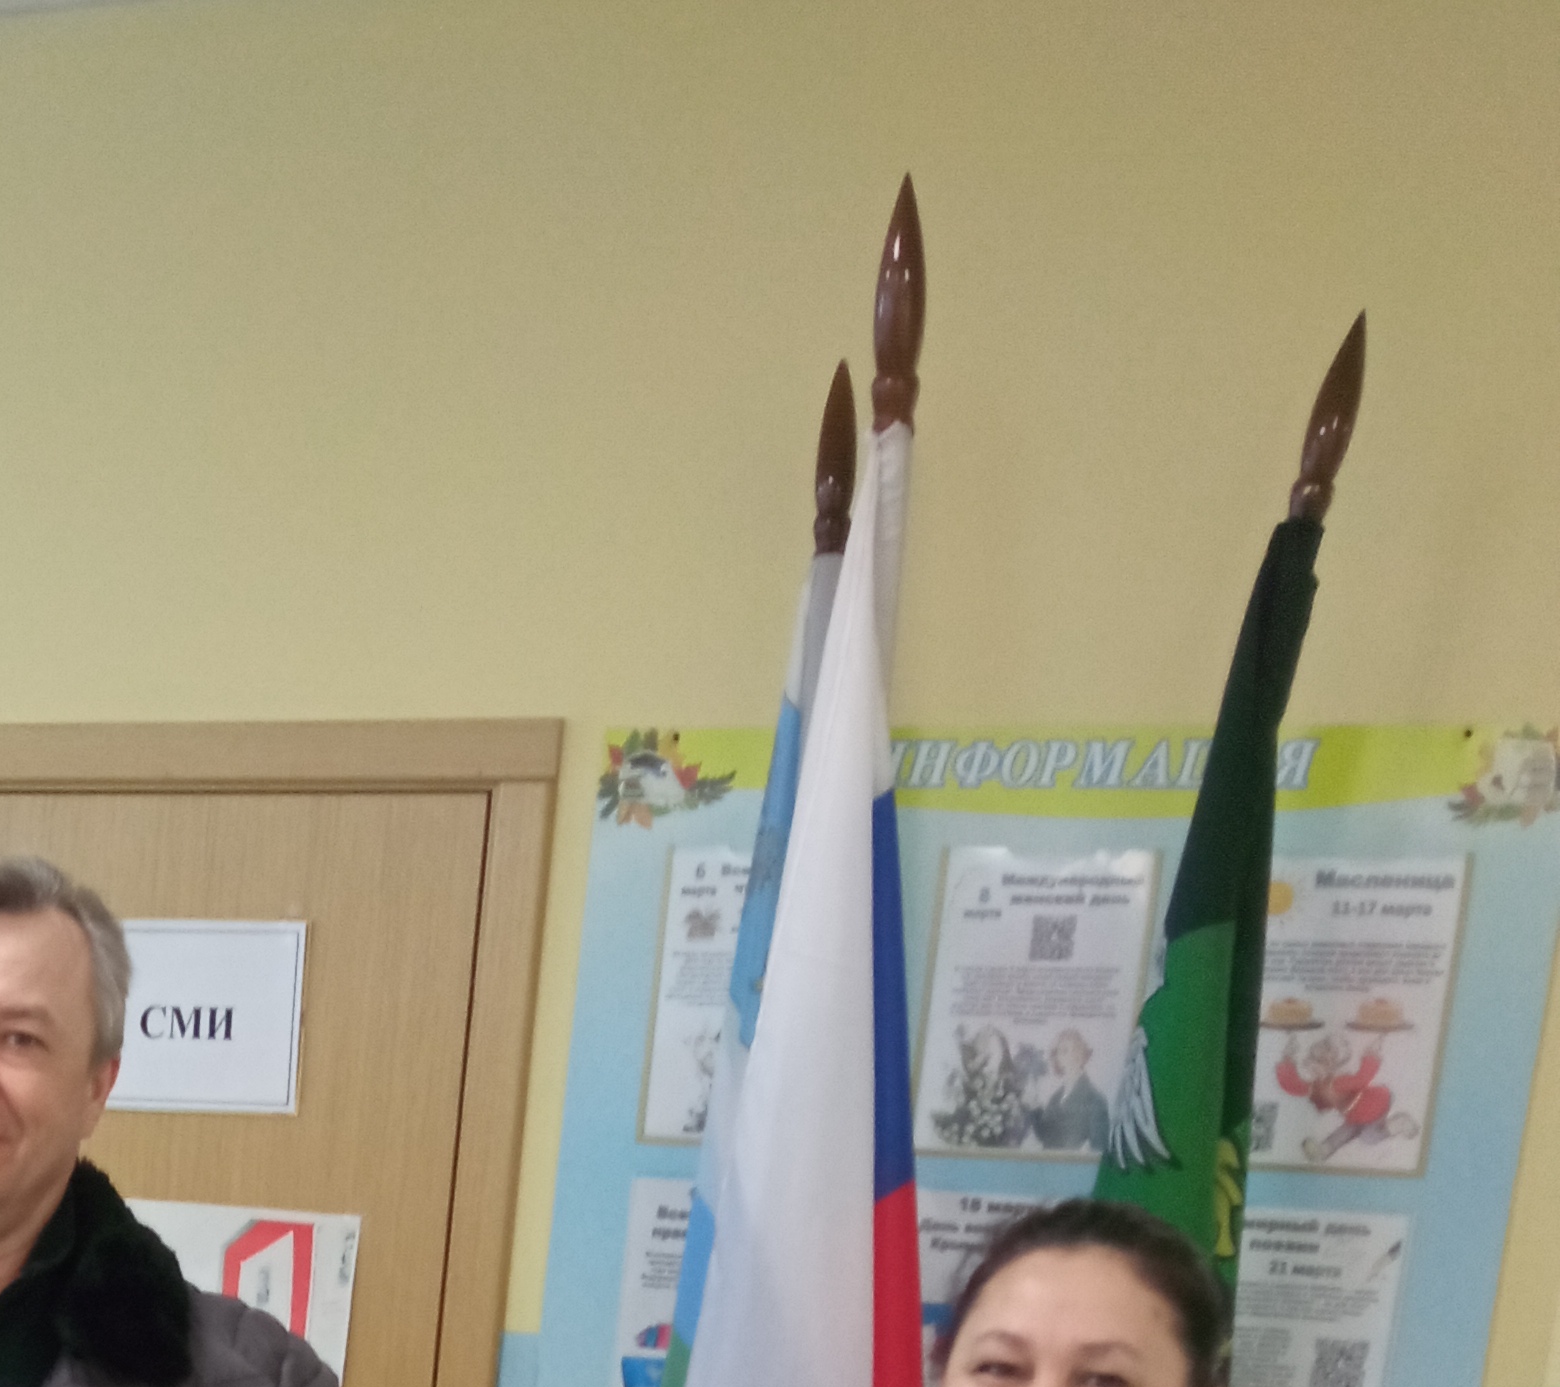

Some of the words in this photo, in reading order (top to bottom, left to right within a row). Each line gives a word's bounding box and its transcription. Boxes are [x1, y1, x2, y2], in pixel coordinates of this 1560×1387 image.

[1315, 869, 1456, 890] Масленица
[1332, 901, 1378, 917] 11-17
[1382, 903, 1433, 919] марта
[139, 1004, 234, 1041] СМИ
